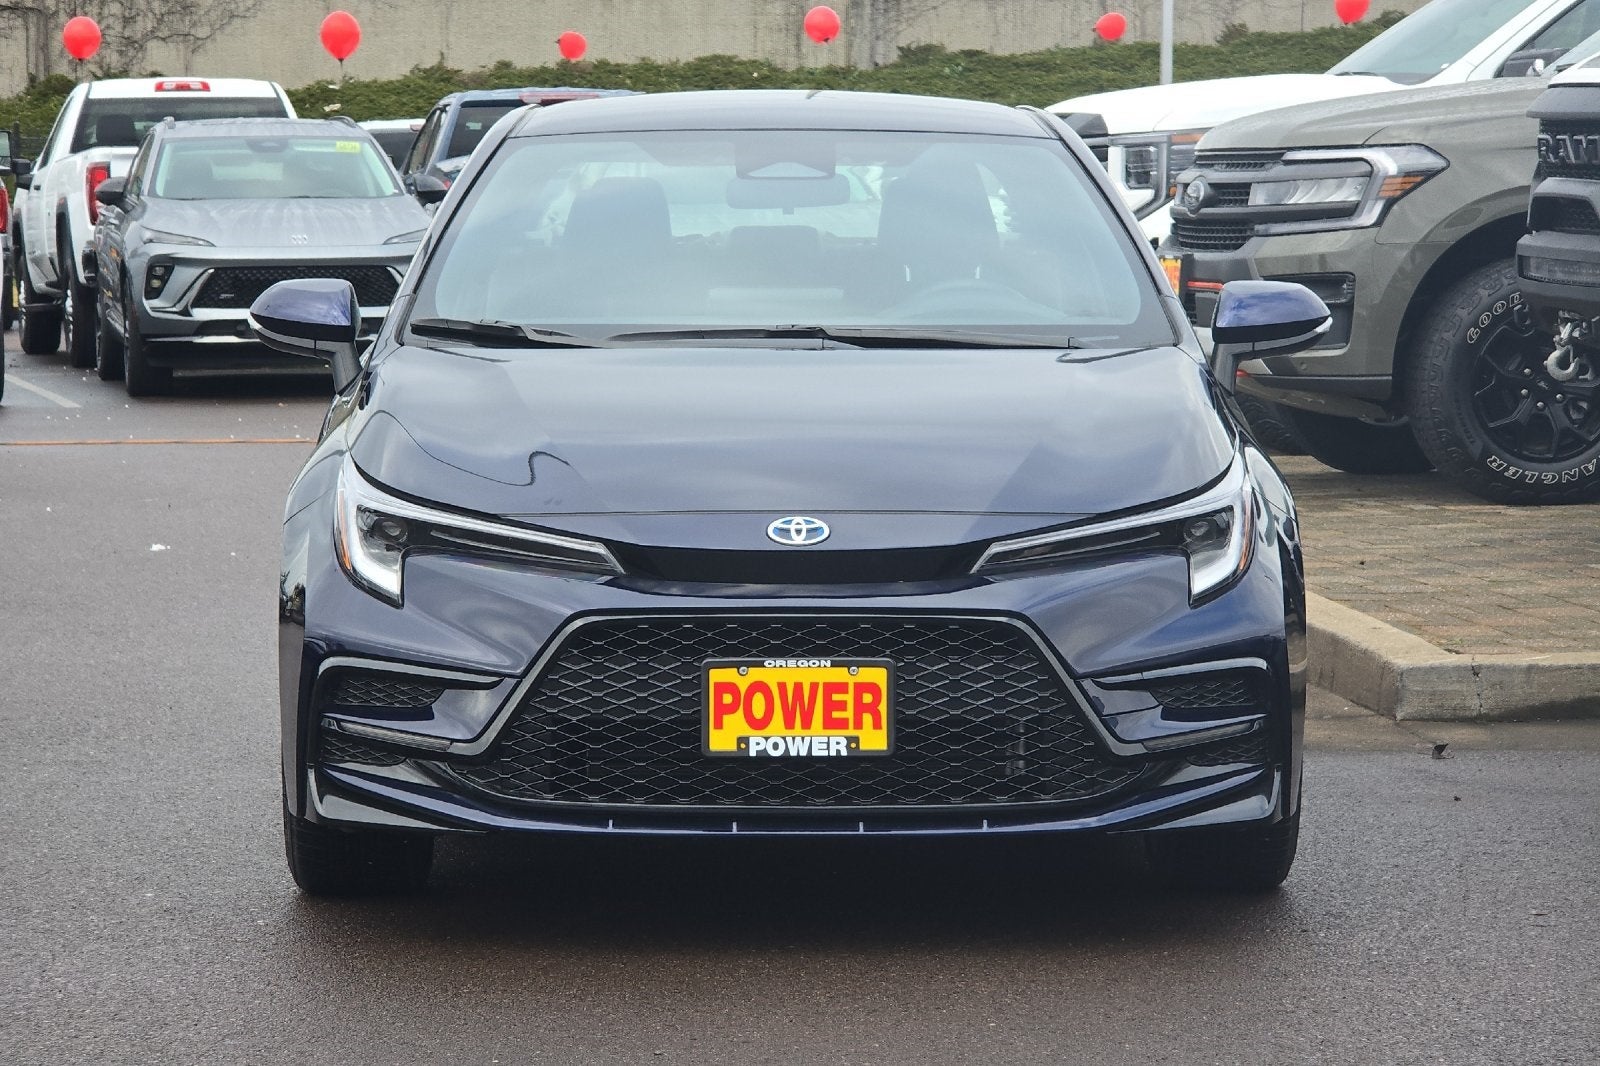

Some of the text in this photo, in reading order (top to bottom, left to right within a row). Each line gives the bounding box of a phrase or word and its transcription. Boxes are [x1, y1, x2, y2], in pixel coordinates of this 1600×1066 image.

[1537, 134, 1600, 163] RAM
[1486, 455, 1600, 485] ANGLER
[763, 659, 832, 668] OREGON
[713, 680, 883, 731] POWER
[749, 736, 848, 757] POWER
